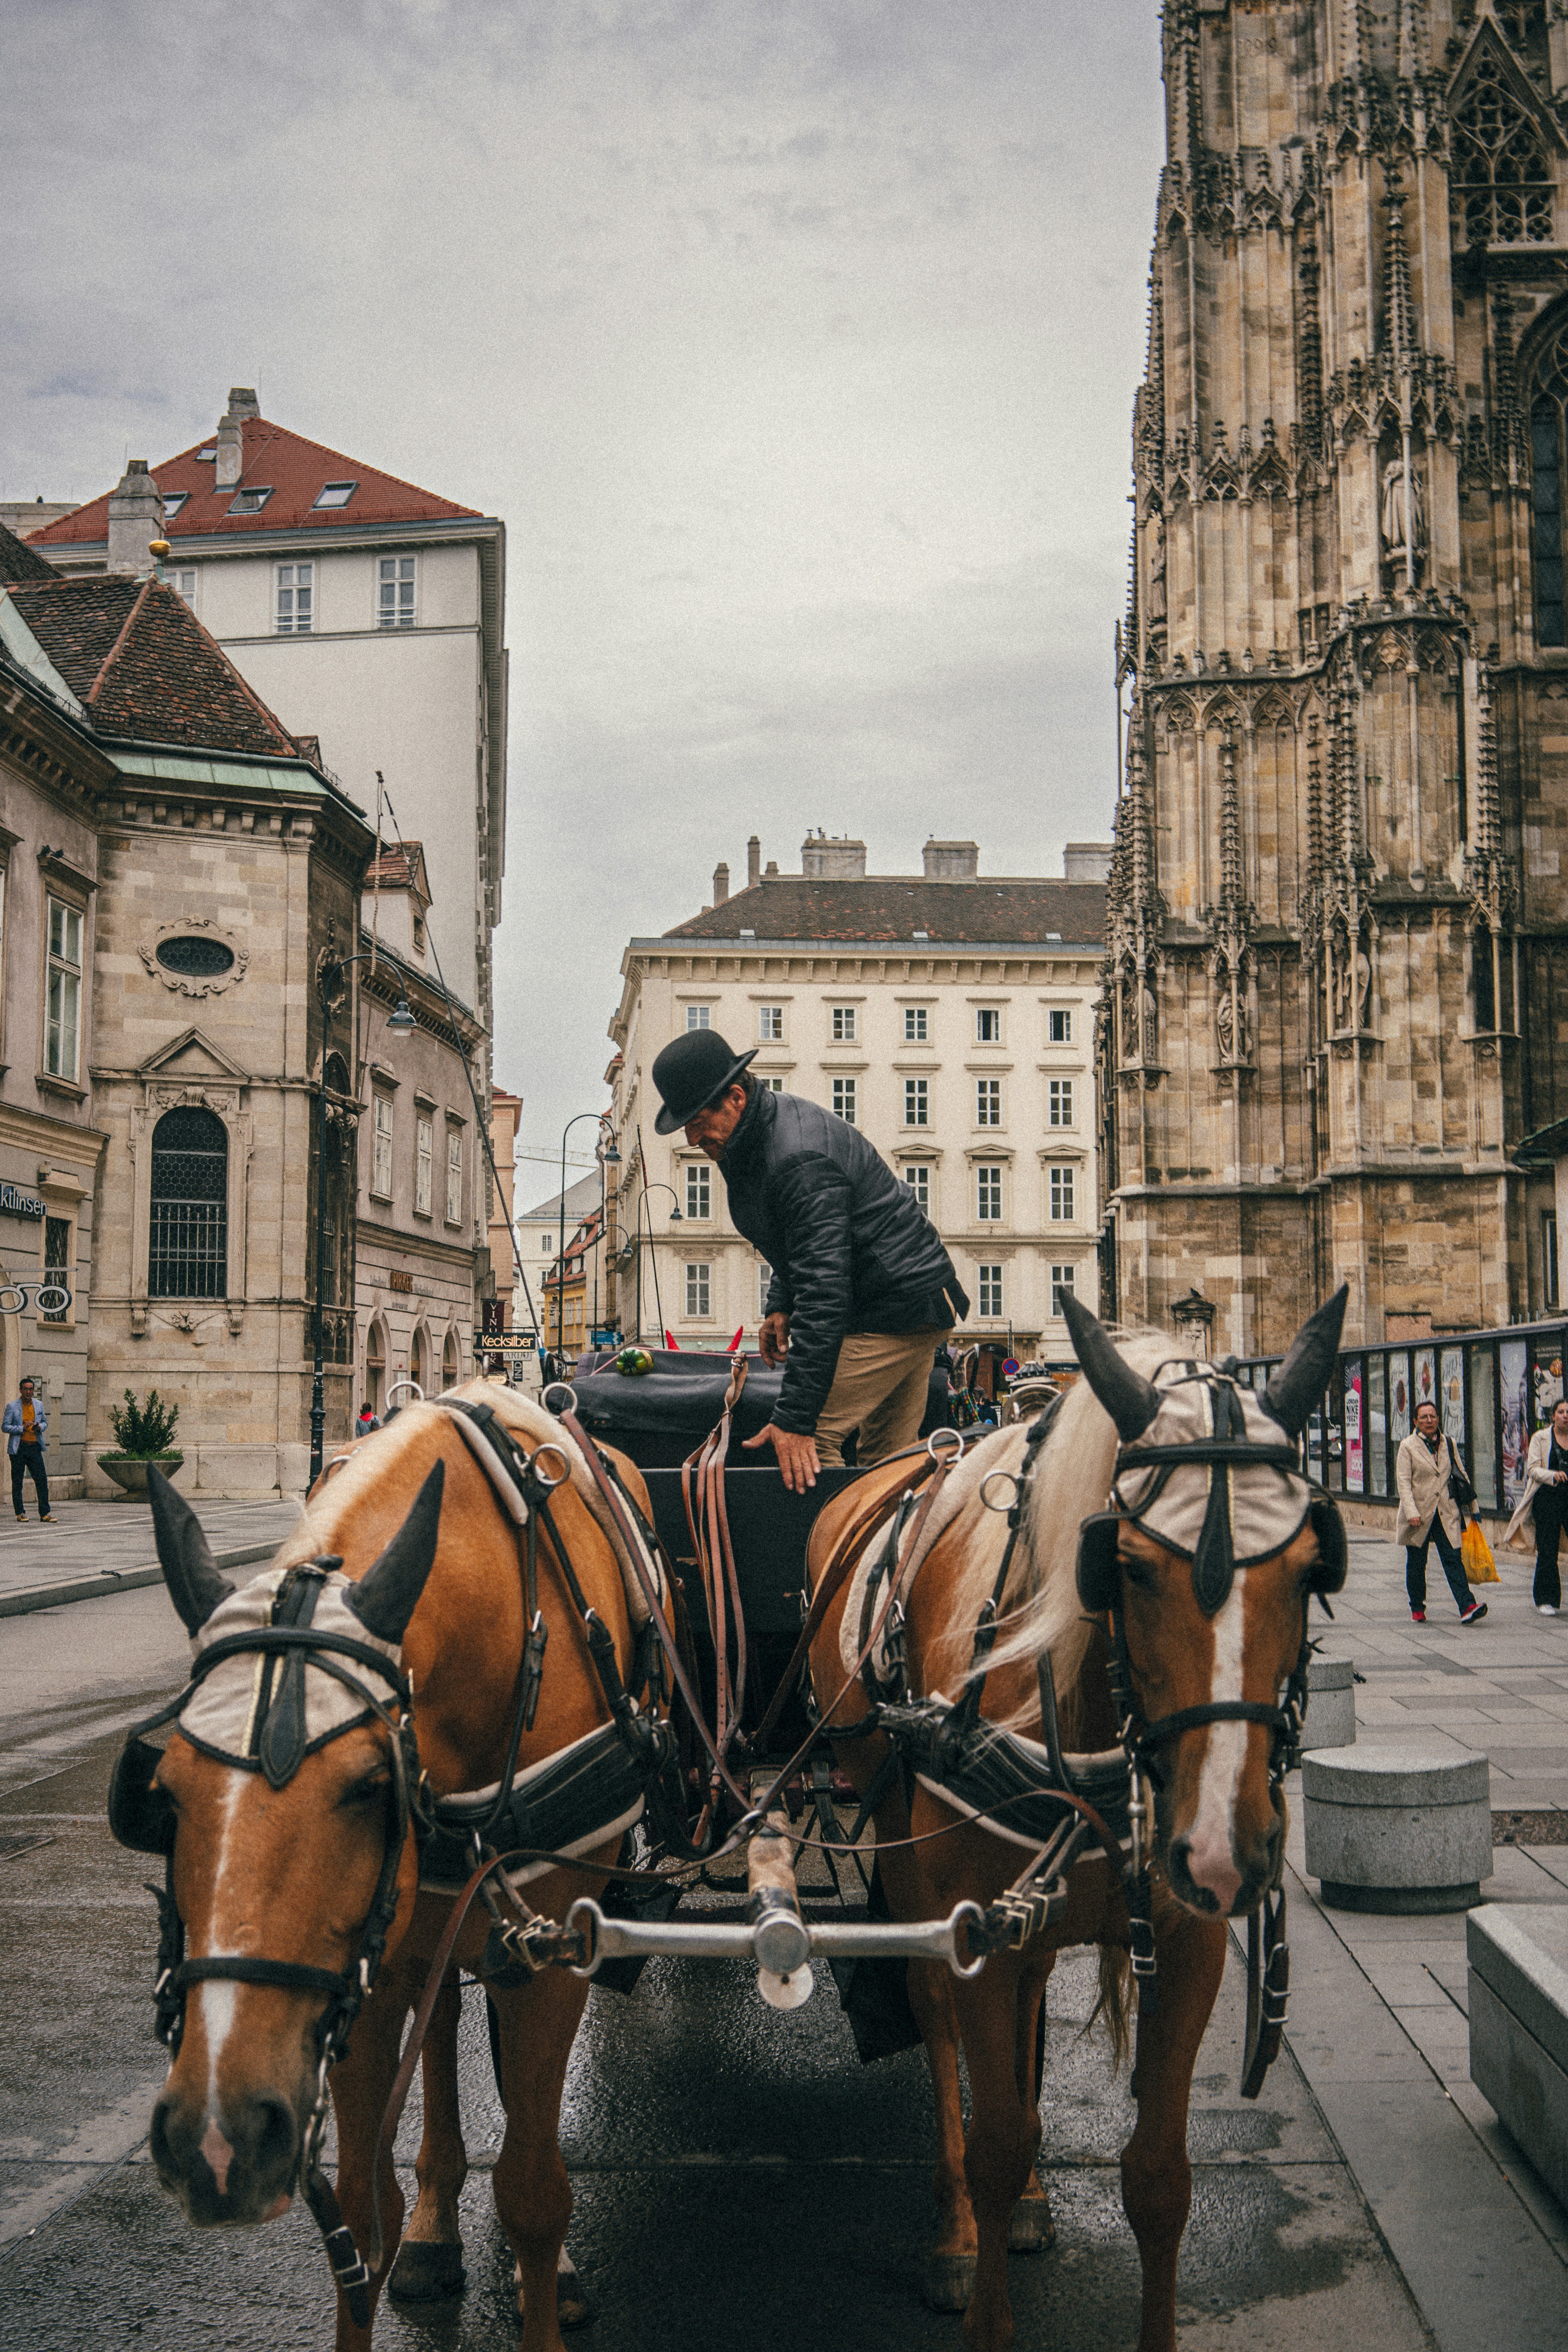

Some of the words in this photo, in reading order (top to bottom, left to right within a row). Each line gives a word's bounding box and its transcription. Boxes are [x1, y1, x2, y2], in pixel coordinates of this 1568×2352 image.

[393, 1271, 413, 1292] PIRKER
[482, 1335, 534, 1347] Kecksilber
[1346, 1405, 1358, 1415] NIKE
